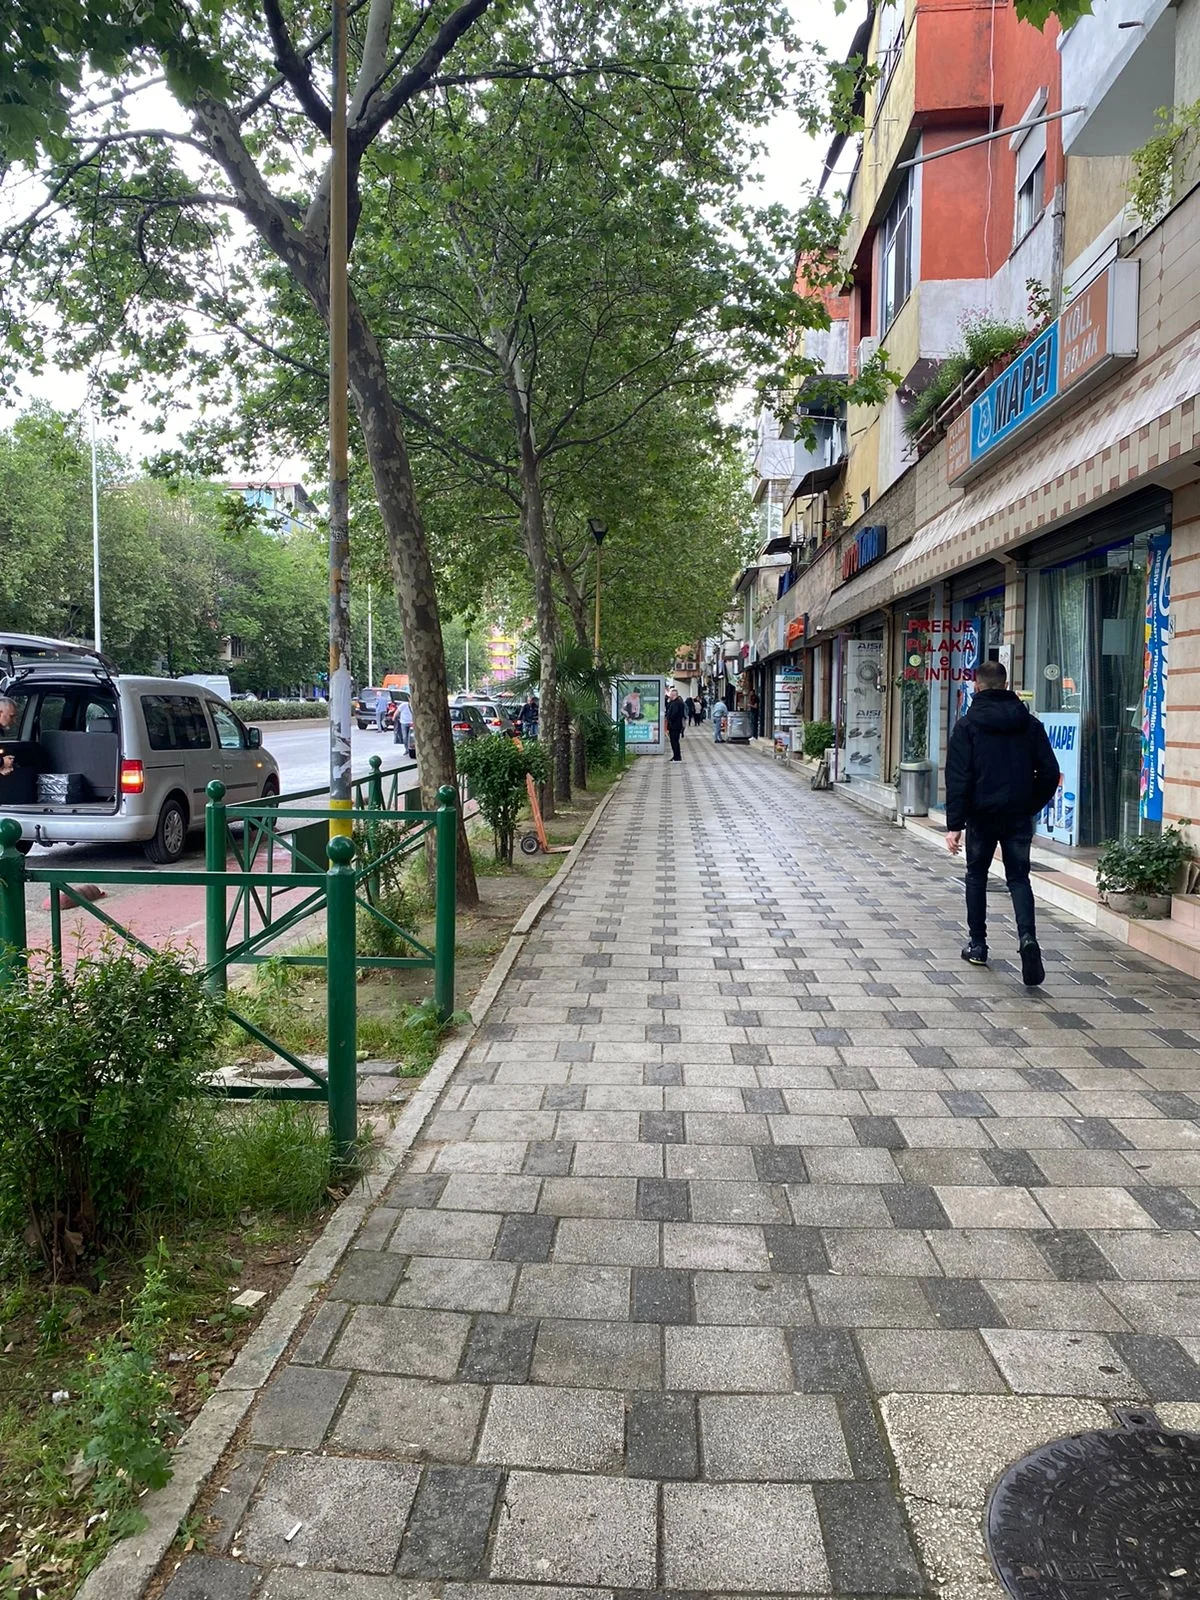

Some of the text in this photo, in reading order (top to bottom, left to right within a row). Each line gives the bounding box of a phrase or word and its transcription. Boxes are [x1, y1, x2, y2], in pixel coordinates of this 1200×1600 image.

[1064, 296, 1092, 347] KOLL
[993, 336, 1053, 434] MAPEI
[1152, 549, 1161, 587] ADESIVI
[908, 619, 973, 633] PRERJE
[857, 642, 883, 650] AISI
[906, 639, 974, 653] PLLAKA
[940, 656, 949, 665] e
[1049, 725, 1076, 751] MAPEI
